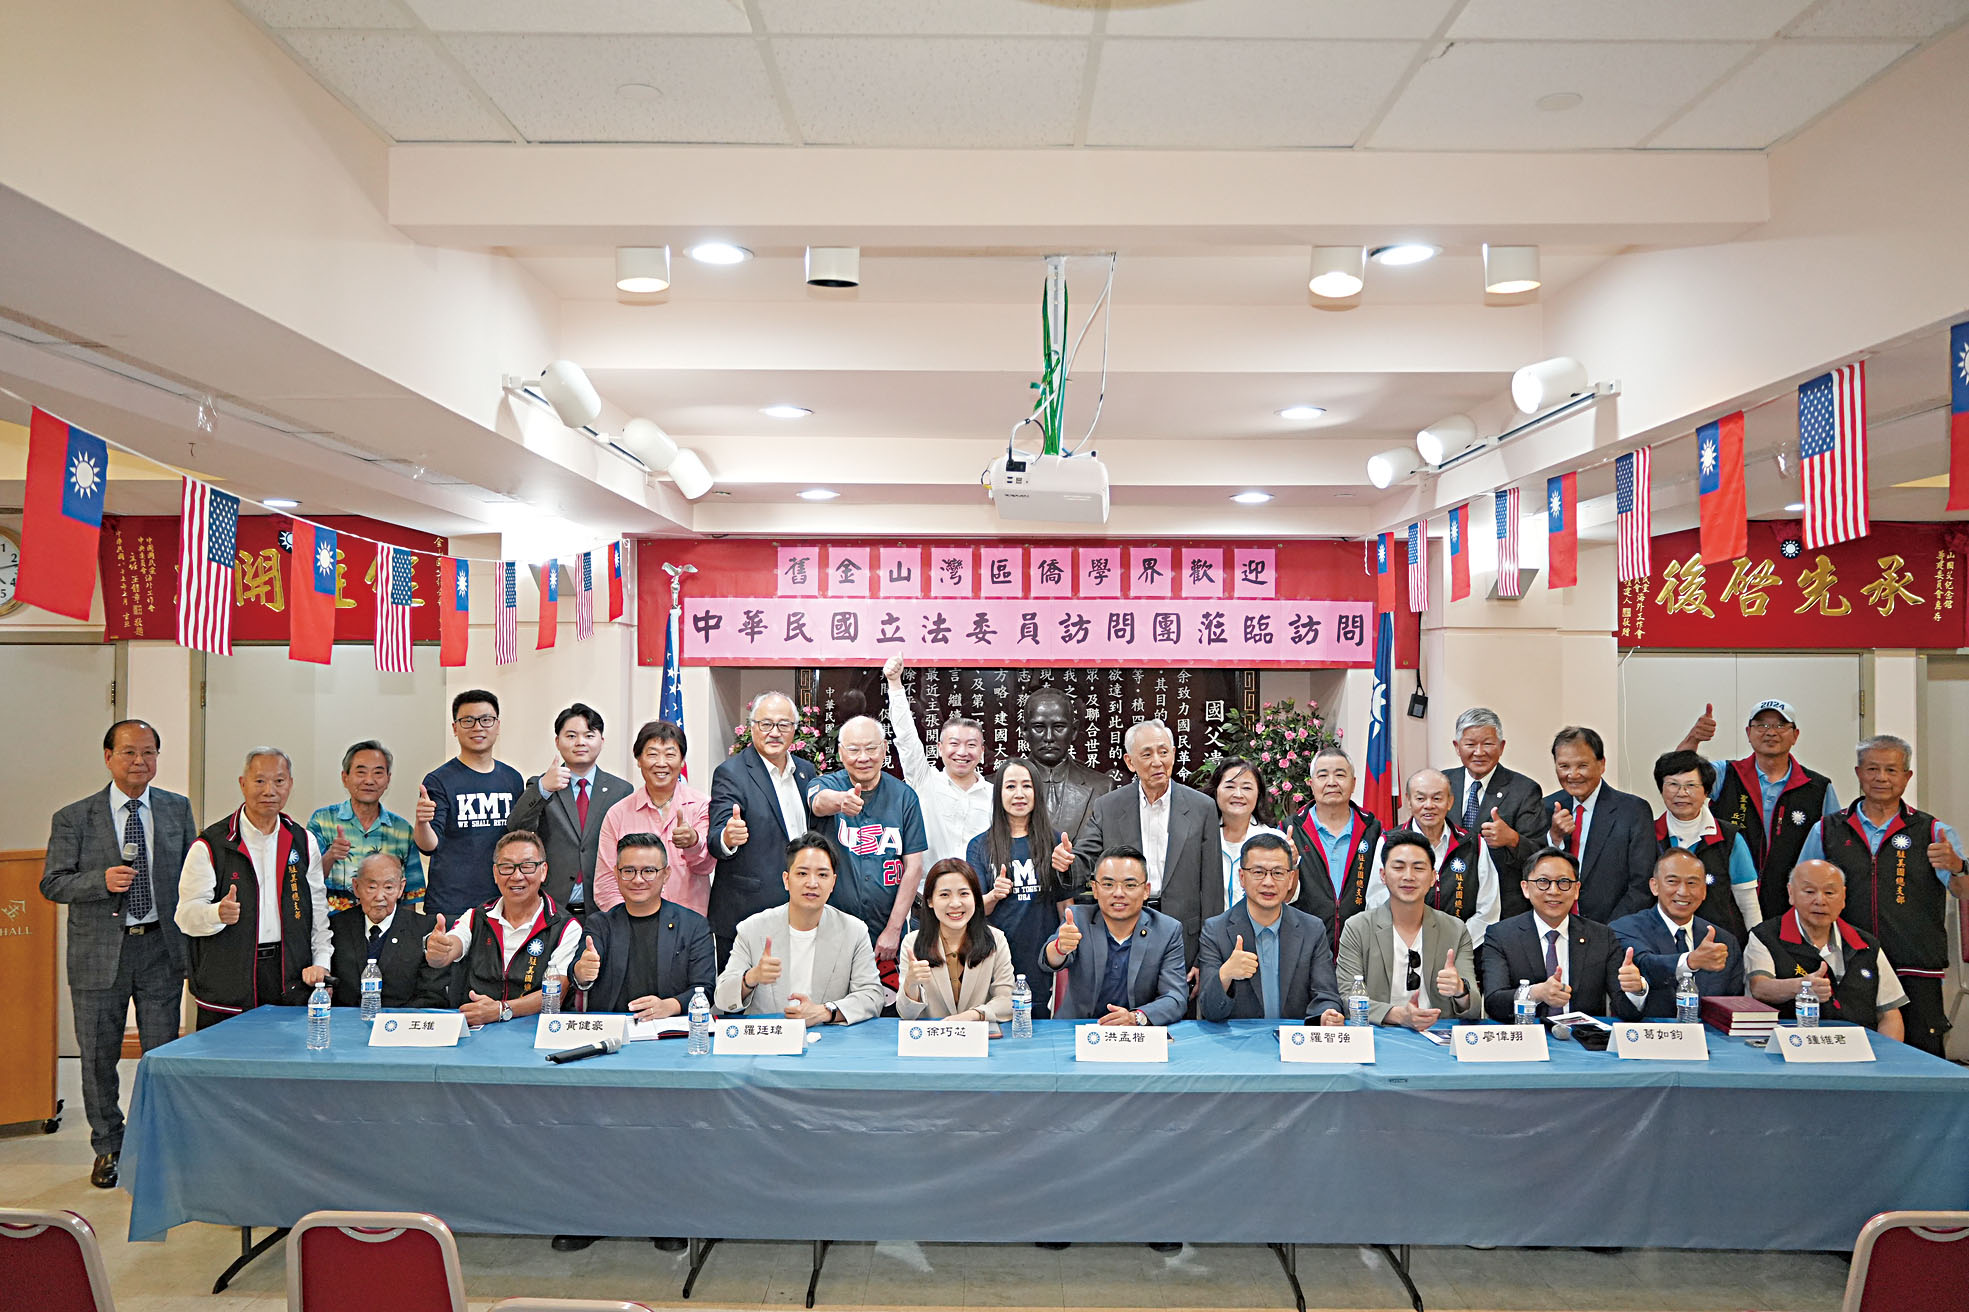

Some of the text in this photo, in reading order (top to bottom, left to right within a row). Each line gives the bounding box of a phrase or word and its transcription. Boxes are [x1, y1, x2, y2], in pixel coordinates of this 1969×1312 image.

[785, 556, 1268, 588] 舊金山灣區僑學界歡迎
[693, 609, 1365, 646] 中華民國立法委員訪問團蒞臨訪問
[1760, 700, 1785, 711] 2024
[456, 792, 513, 821] KMT
[457, 820, 469, 828] WE
[471, 819, 491, 828] SHALL
[837, 816, 904, 857] USA
[523, 956, 538, 992] 駐美國總
[408, 1020, 435, 1031] 王維
[566, 1020, 604, 1031] 黃健豪
[926, 1026, 966, 1038] 徐巧芯
[1104, 1031, 1145, 1043] 洪孟楷
[1310, 1031, 1351, 1044] 羅智強
